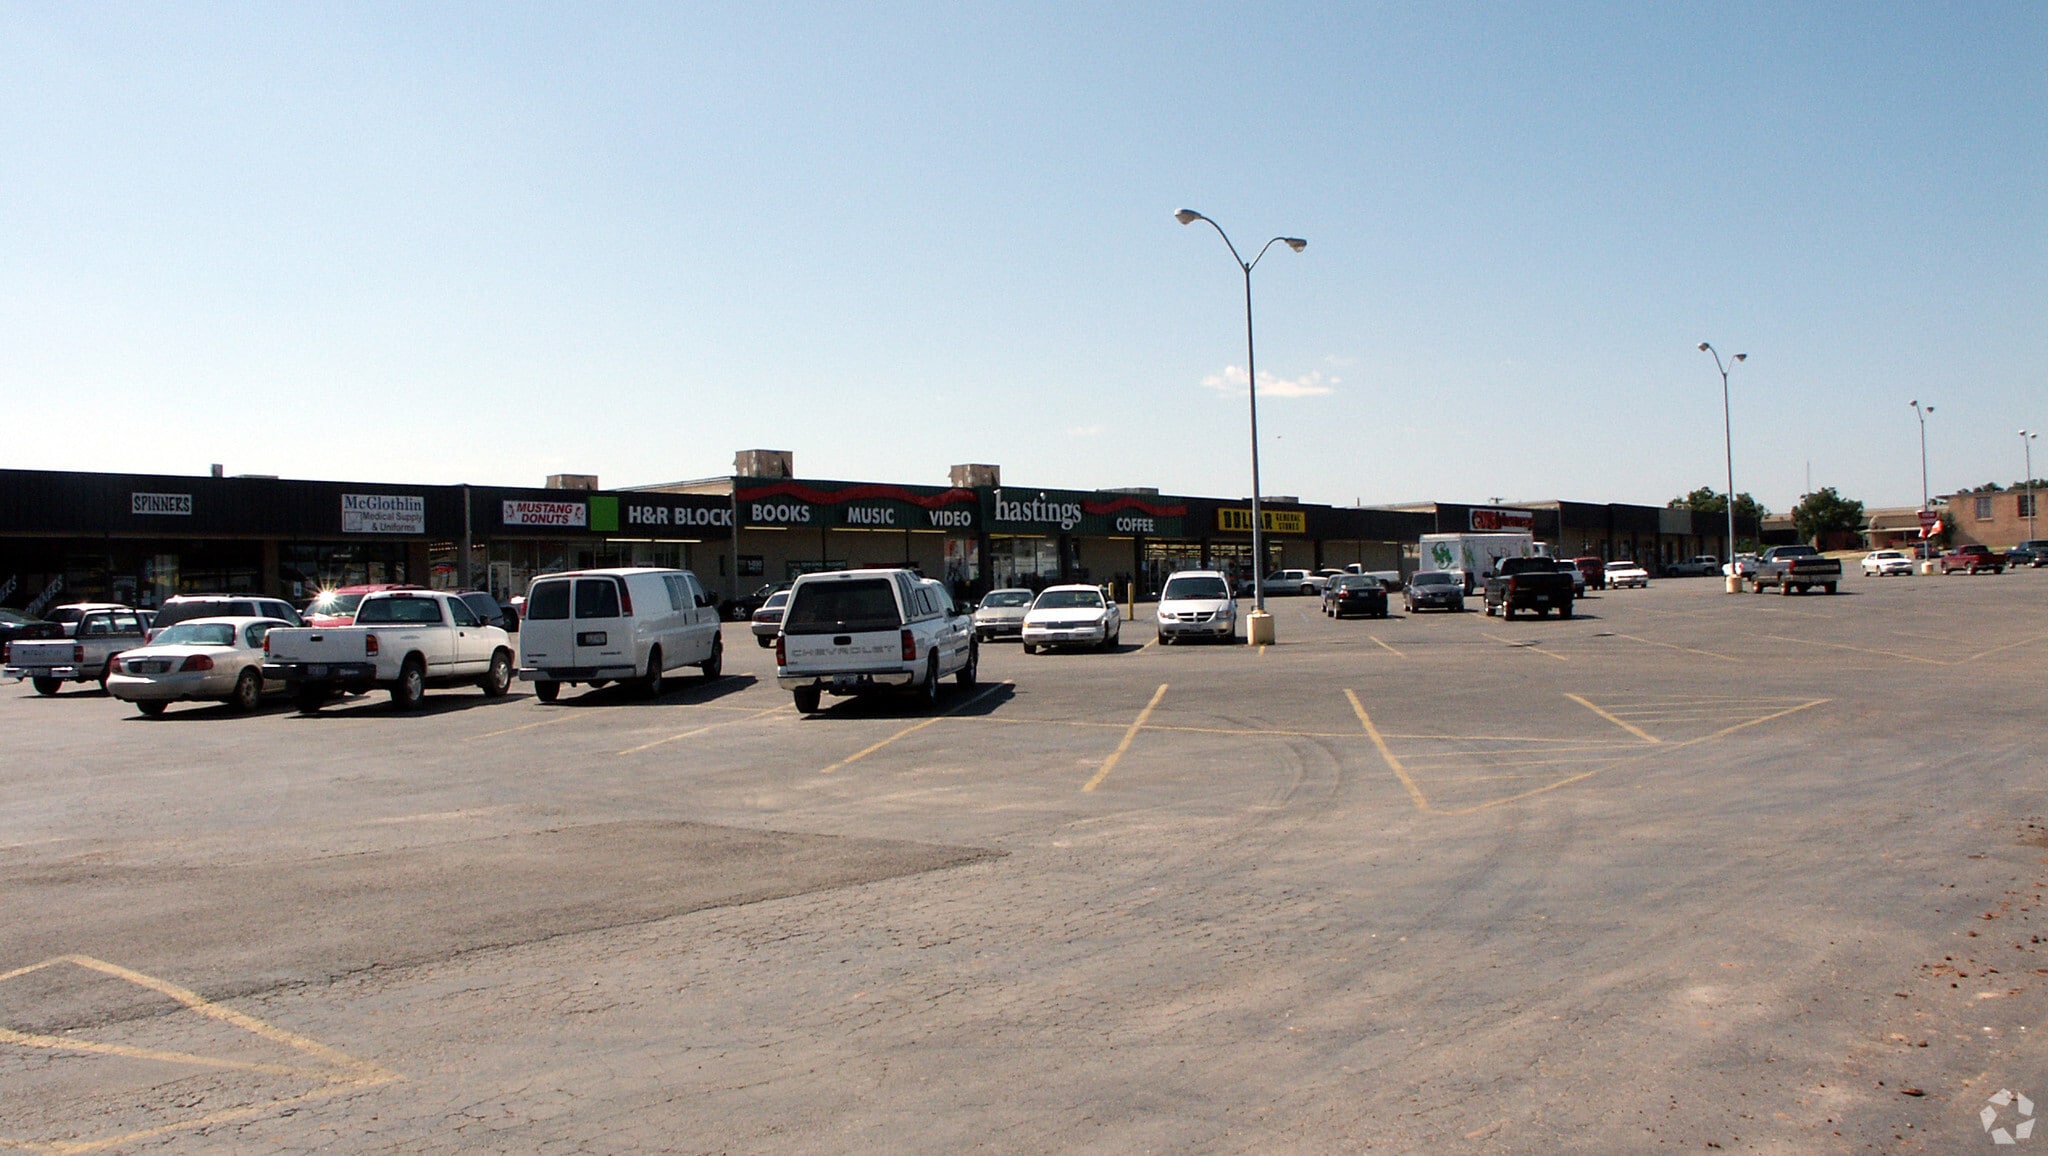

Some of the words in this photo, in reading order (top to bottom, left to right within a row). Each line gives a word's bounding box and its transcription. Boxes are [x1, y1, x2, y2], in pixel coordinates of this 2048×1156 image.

[134, 495, 190, 512] SPINNERS
[344, 496, 422, 511] McGlothlin
[517, 502, 573, 514] MUSTANG
[994, 489, 1082, 530] hastings
[363, 512, 394, 521] Medical
[395, 513, 422, 523] Supply
[521, 514, 569, 524] DONUTS
[628, 505, 669, 525] H&R
[674, 507, 733, 527] BLOCK
[751, 503, 811, 522] BOOKS
[848, 507, 895, 524] MUSIC
[929, 510, 971, 526] VIDEO
[372, 523, 378, 531] &
[380, 523, 415, 532] Uniforms
[1116, 517, 1154, 532] COFFEE
[792, 645, 896, 657] CHEVROLET
